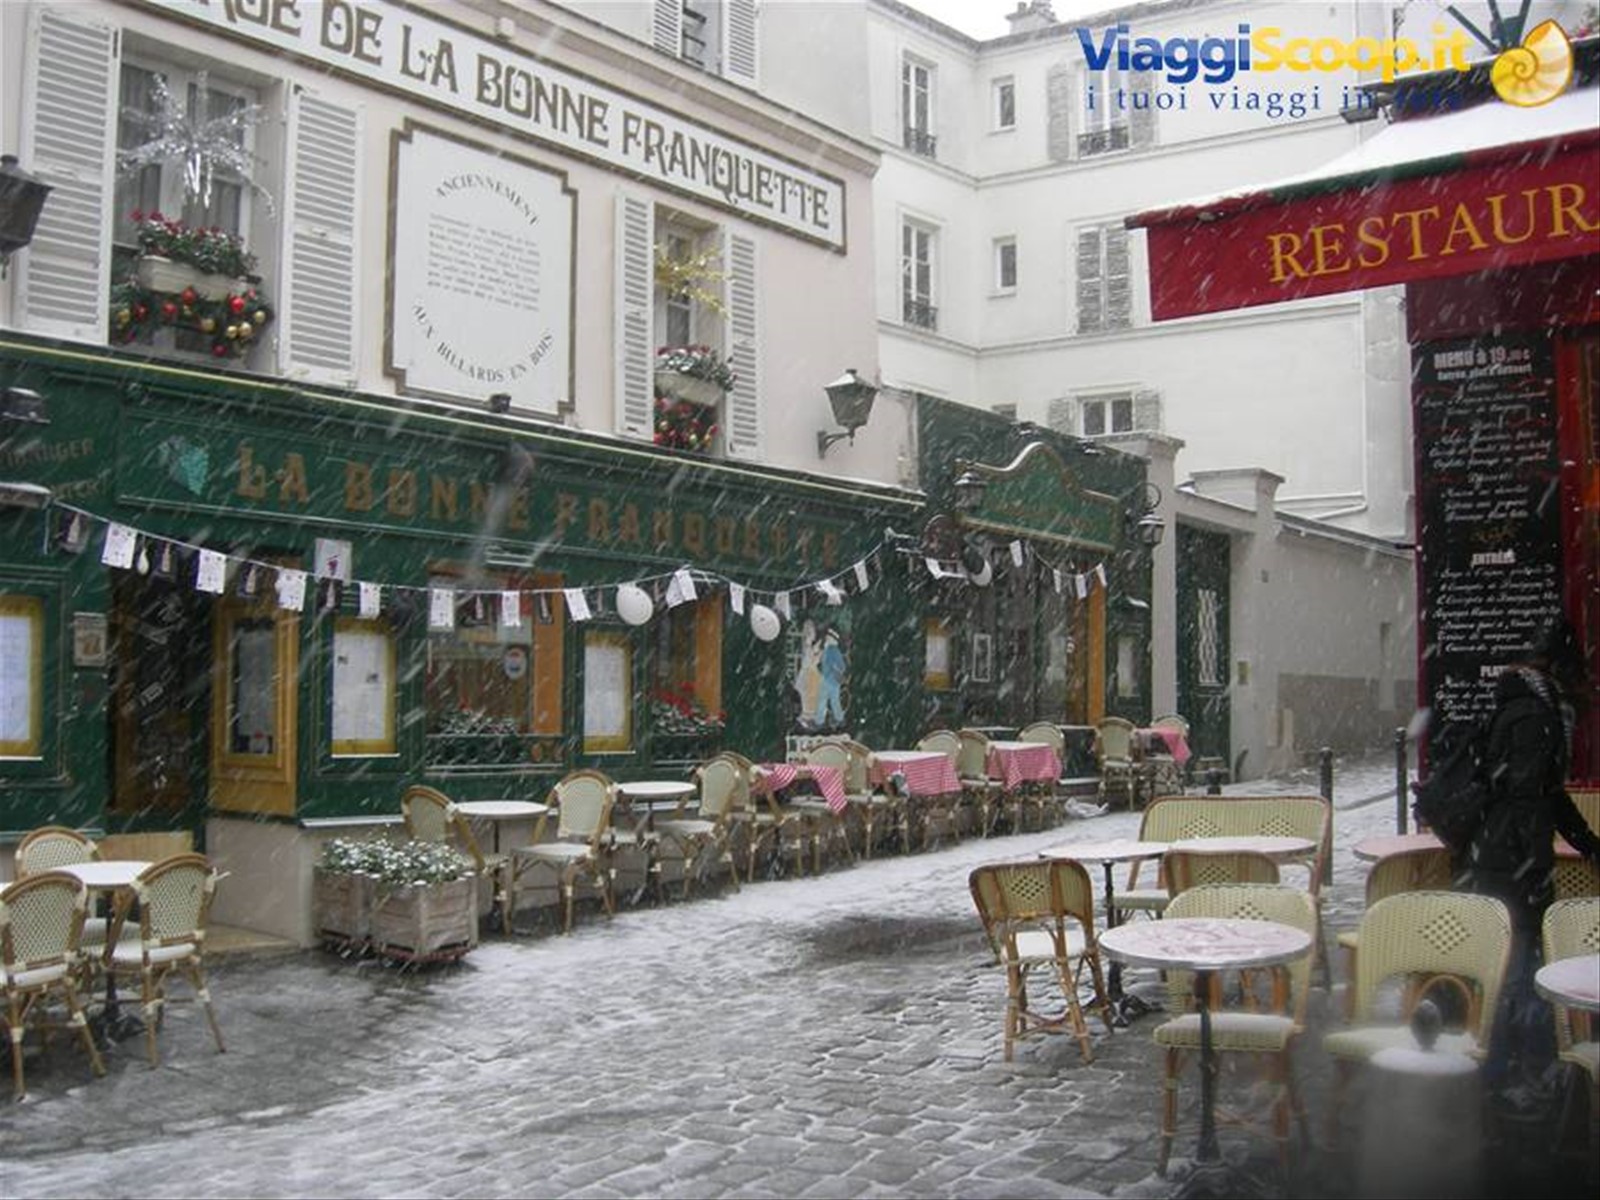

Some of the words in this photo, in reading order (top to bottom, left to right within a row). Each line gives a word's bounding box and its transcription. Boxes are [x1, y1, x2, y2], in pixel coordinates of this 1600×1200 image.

[319, 0, 383, 66] DE
[400, 25, 459, 94] LA
[476, 53, 609, 149] BONNE
[622, 110, 830, 231] FRANQUETTE
[1266, 183, 1600, 283] RESTAUR
[437, 341, 504, 383] BILLARDS
[236, 442, 310, 504] LA
[345, 460, 530, 531] BONNE
